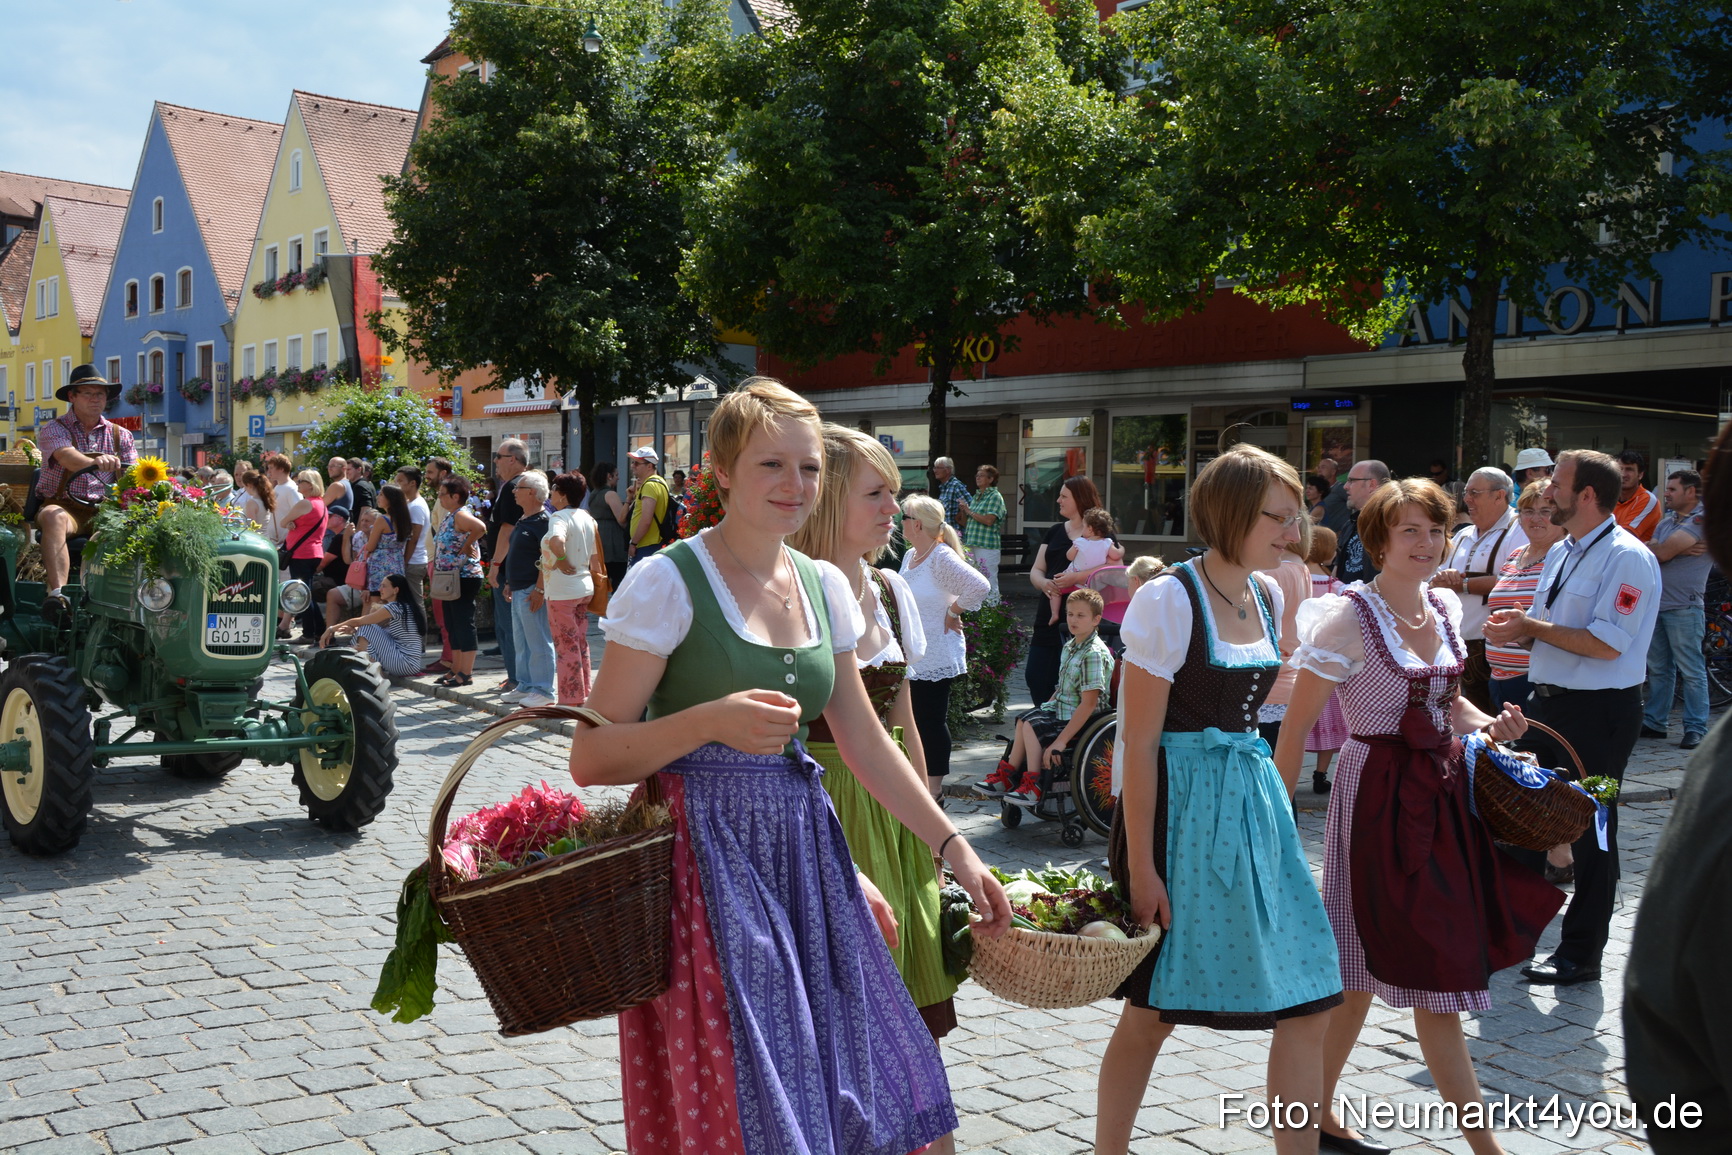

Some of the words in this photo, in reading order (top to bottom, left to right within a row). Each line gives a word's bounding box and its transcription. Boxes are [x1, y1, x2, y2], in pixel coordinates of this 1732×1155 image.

[1399, 279, 1661, 347] ANTON
[252, 417, 262, 435] P
[219, 617, 237, 629] NM
[211, 630, 230, 643] GO
[233, 630, 251, 643] 15
